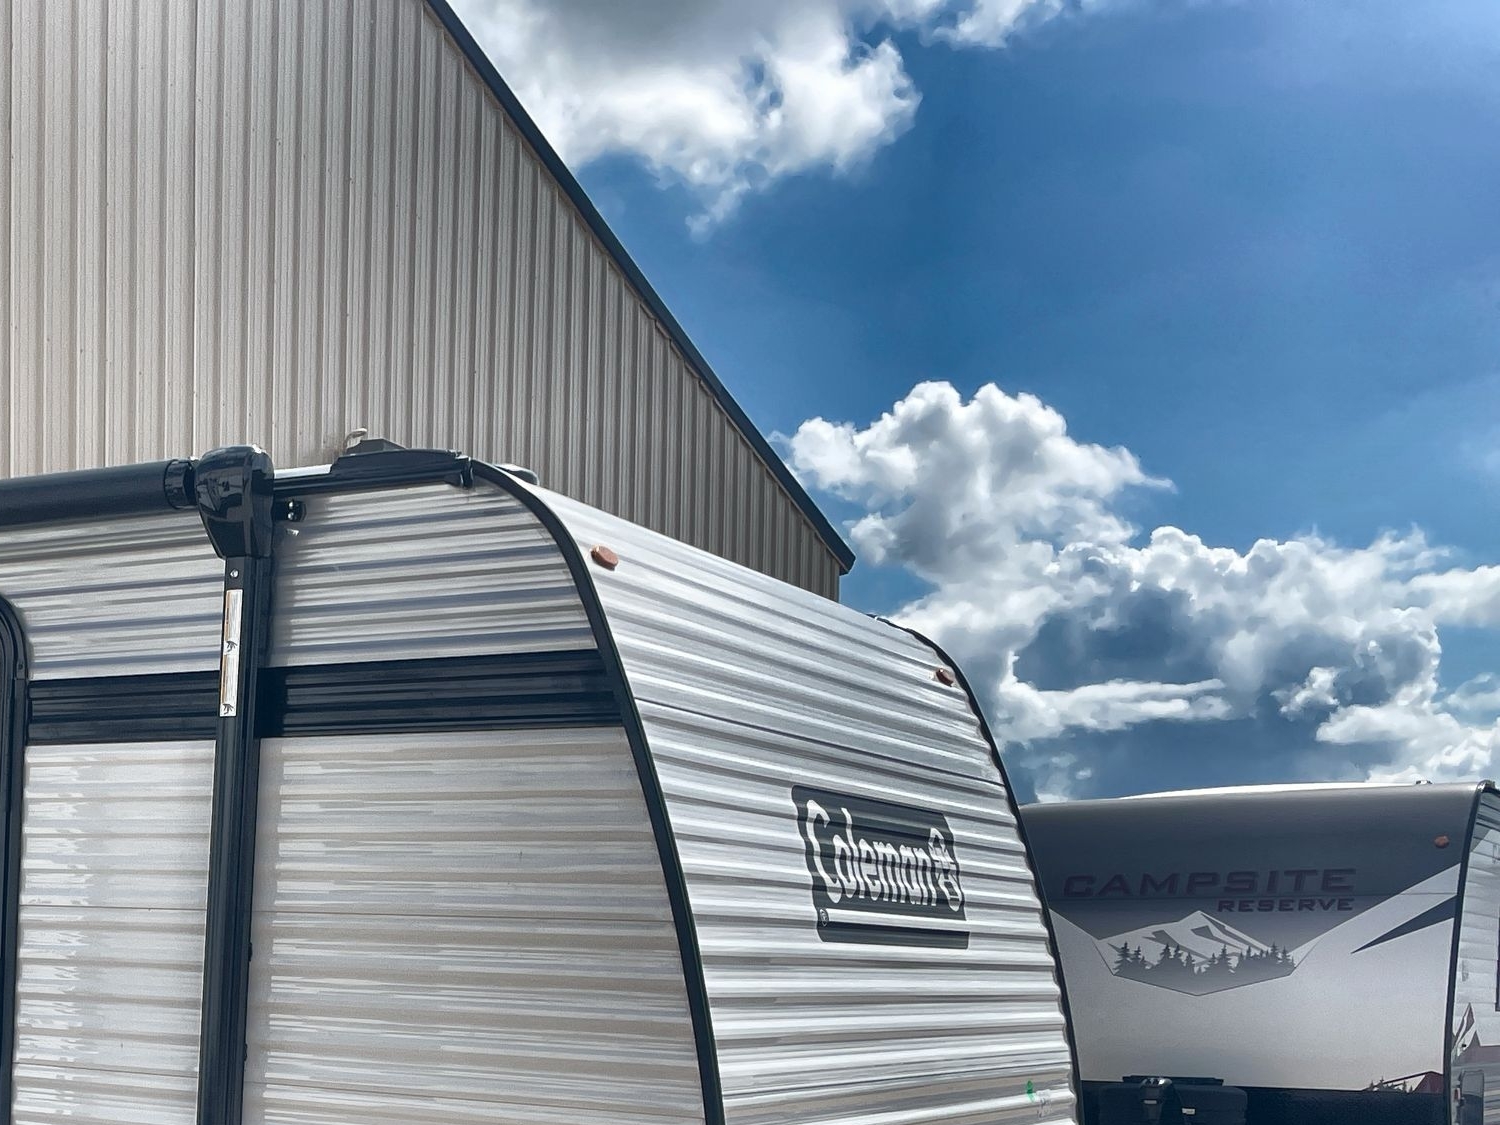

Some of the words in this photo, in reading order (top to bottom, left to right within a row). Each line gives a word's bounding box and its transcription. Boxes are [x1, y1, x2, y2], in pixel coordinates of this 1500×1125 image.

[806, 799, 937, 904] Coleman
[1063, 868, 1357, 897] CAMPSITE
[1217, 898, 1355, 912] RESERVE
